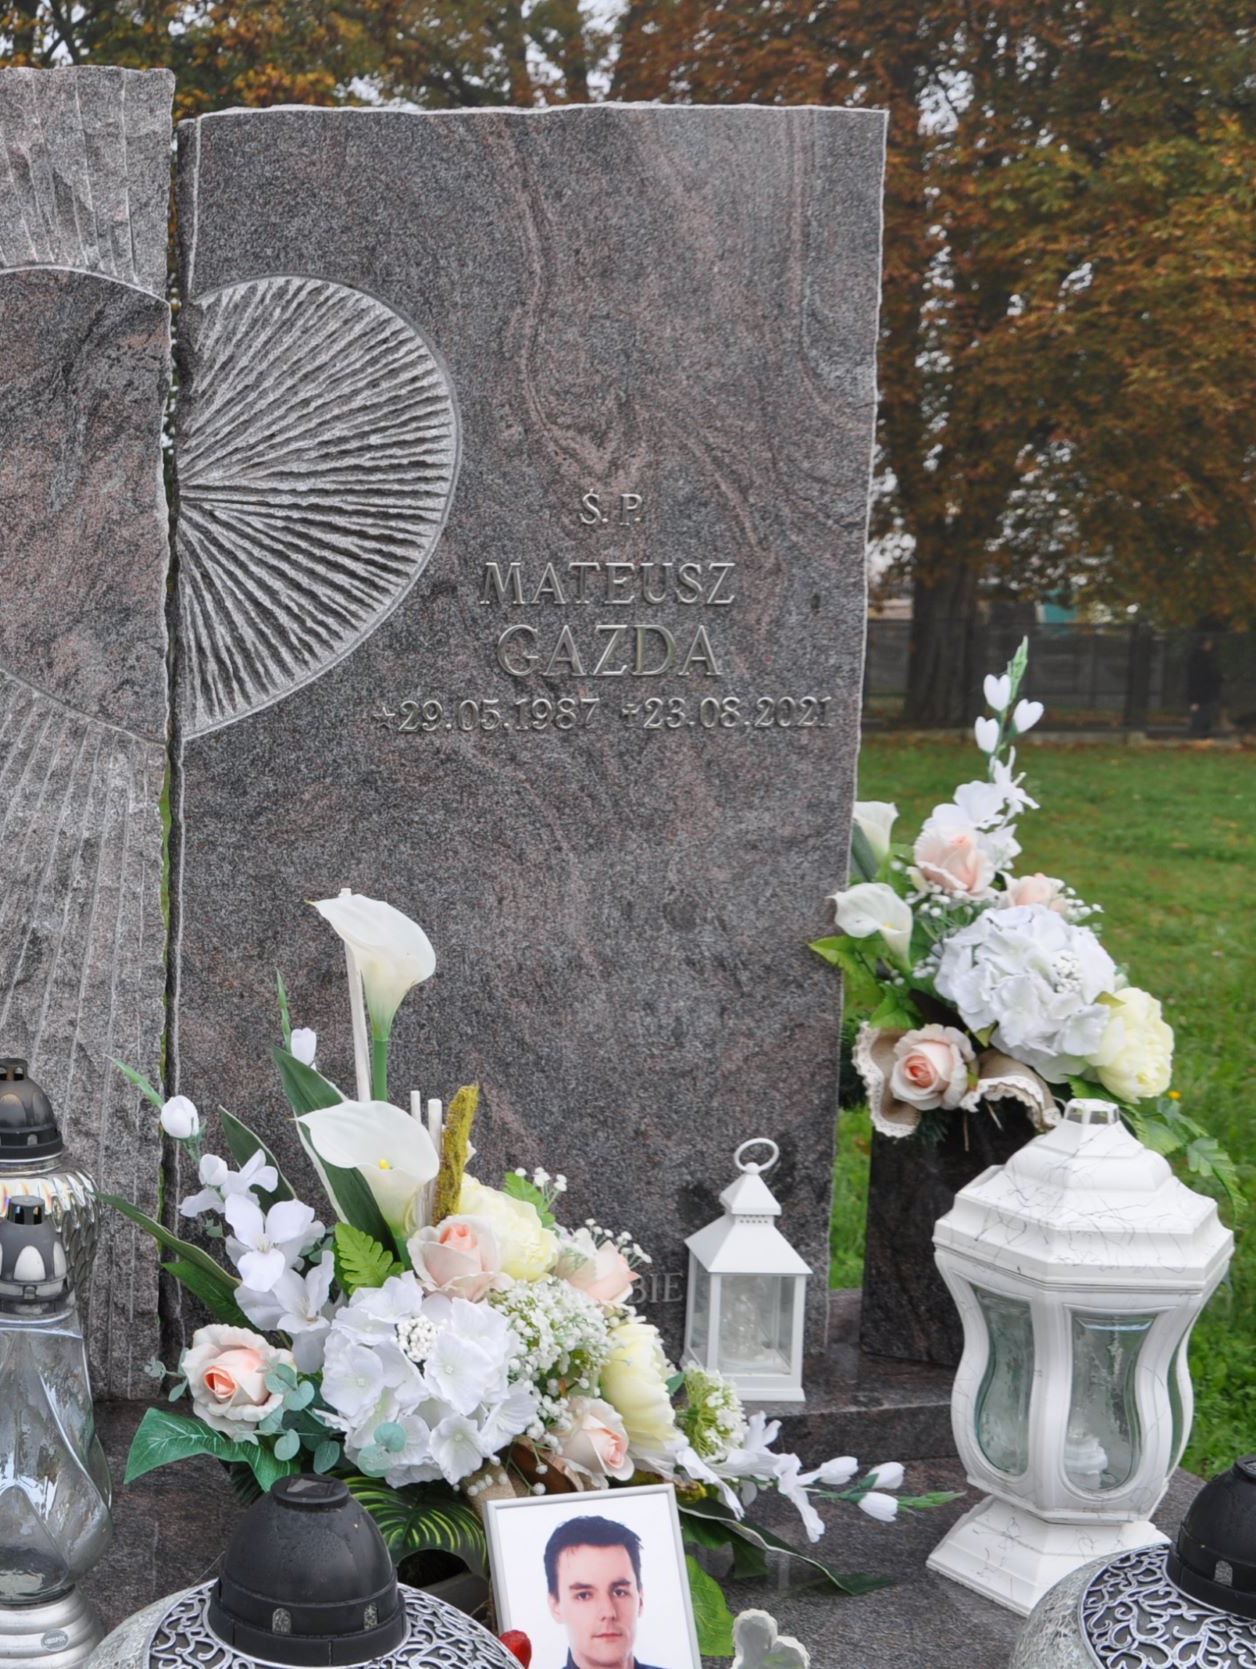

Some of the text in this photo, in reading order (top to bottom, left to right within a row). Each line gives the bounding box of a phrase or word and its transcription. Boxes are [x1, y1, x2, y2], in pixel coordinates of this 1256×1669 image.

[619, 493, 644, 526] P.
[479, 561, 737, 605] MATEUSZ
[496, 624, 723, 677] GAZDA
[398, 696, 833, 732] 29.05.1987 23.08.2021
